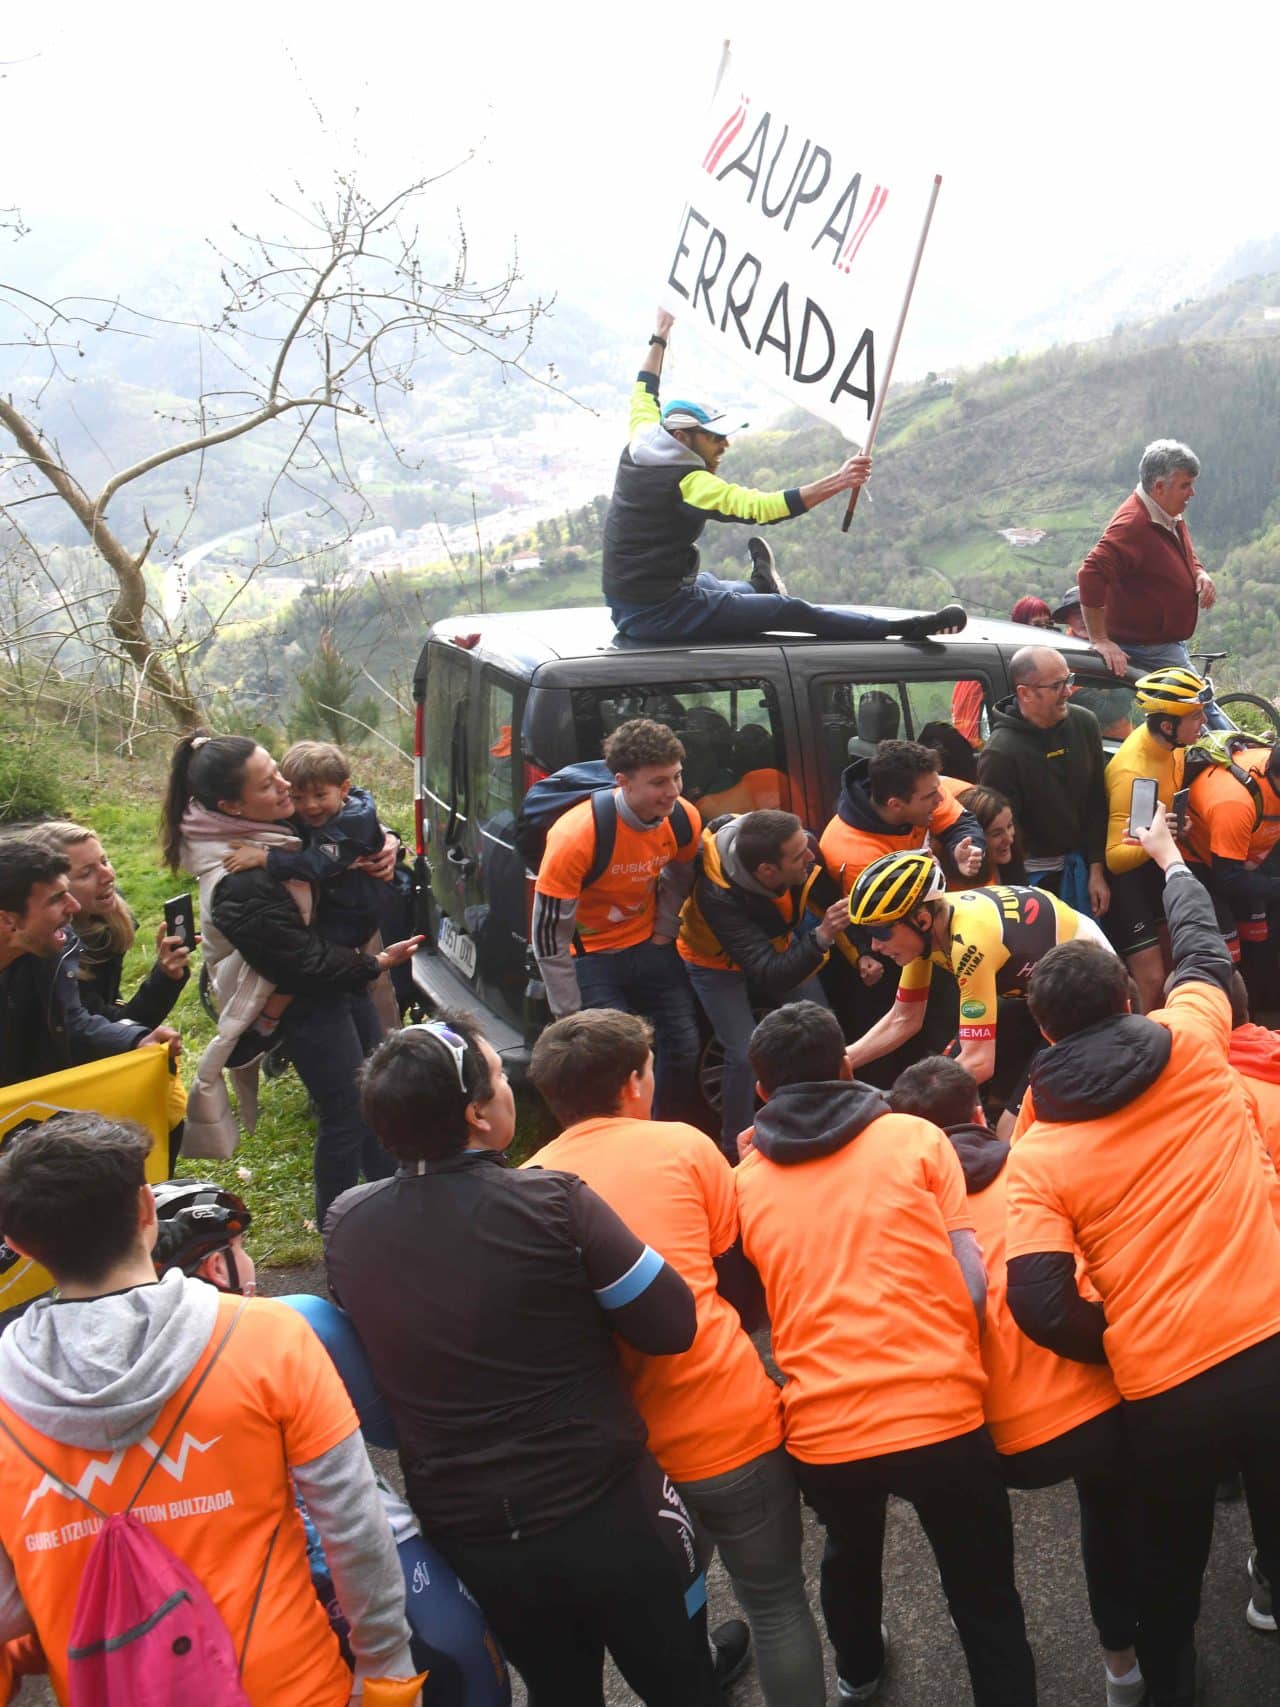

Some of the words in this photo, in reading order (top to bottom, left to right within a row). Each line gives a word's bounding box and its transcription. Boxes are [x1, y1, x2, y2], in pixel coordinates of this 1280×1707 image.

[668, 206, 876, 422] ERRADA
[25, 1530, 61, 1552] GURE
[168, 1489, 235, 1520] BULTZADA
